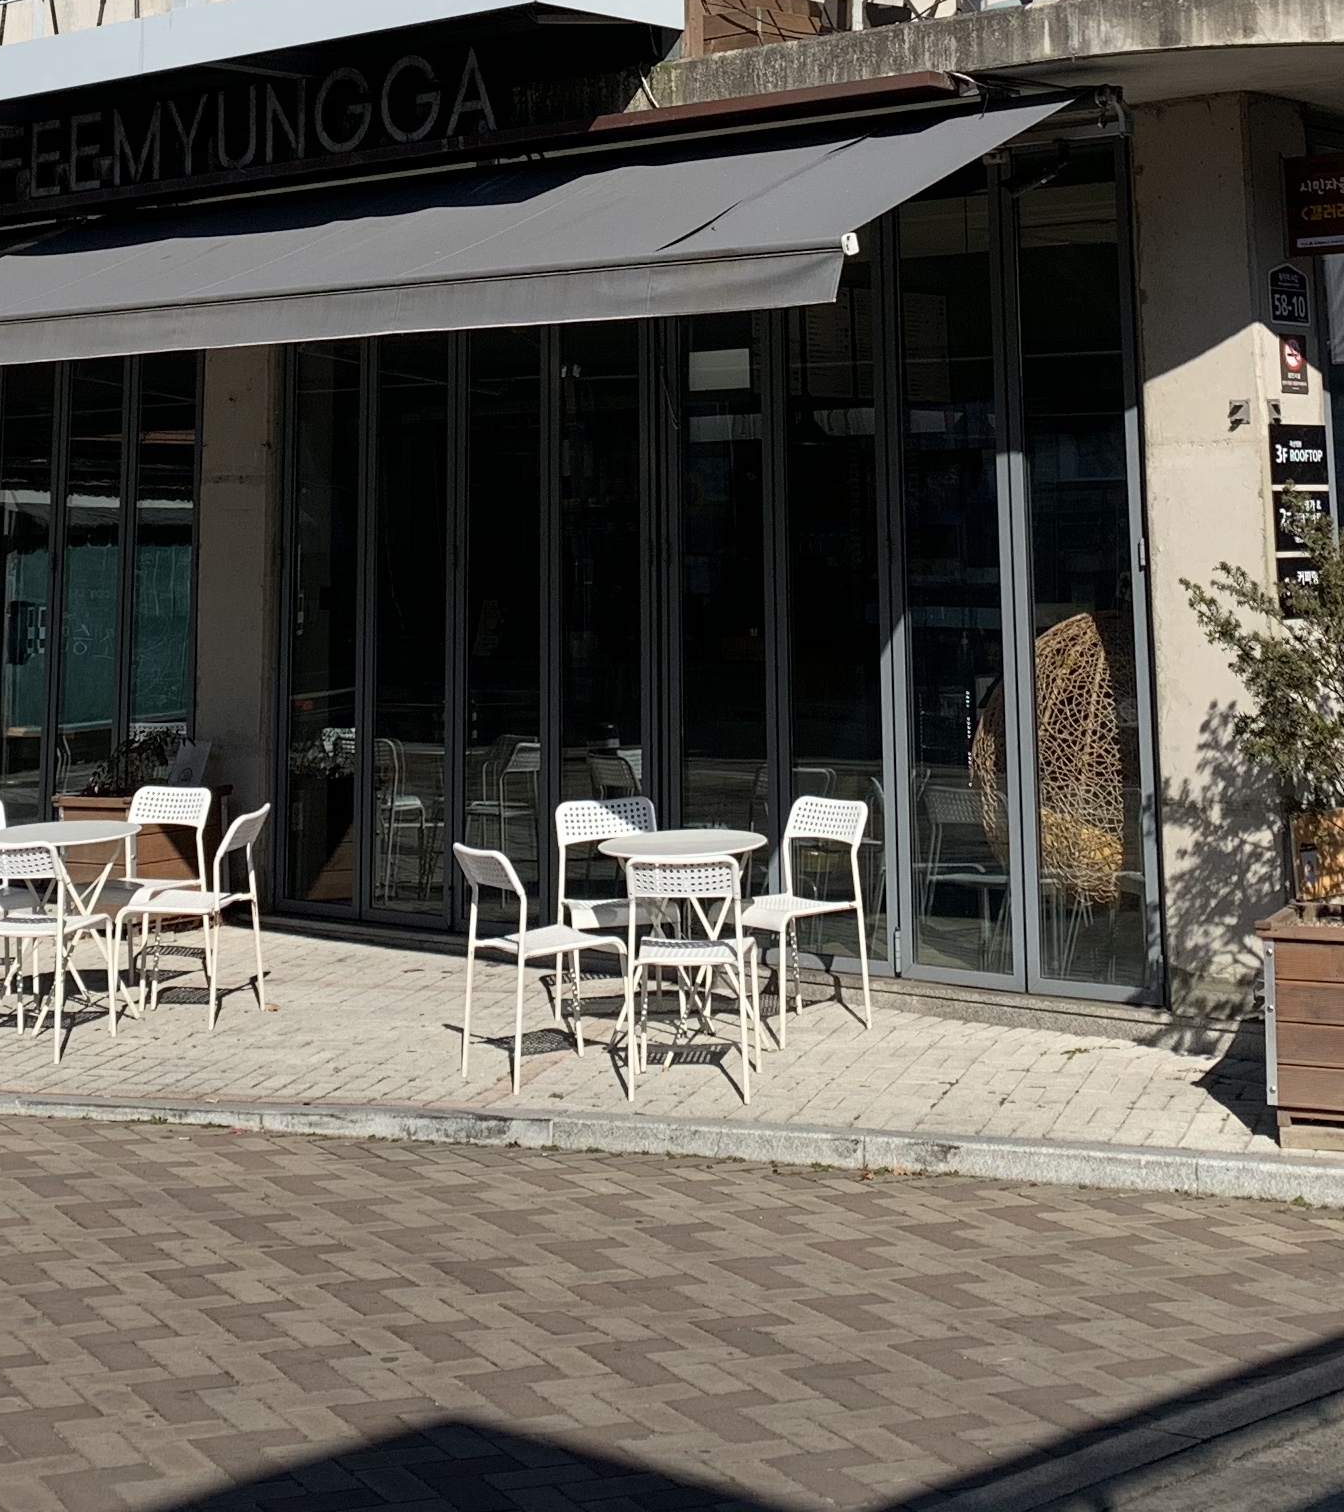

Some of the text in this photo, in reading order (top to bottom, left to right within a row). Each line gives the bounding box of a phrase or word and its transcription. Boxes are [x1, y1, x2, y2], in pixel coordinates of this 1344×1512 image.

[1273, 293, 1306, 318] 58-10
[1274, 443, 1289, 464] 3F
[1289, 448, 1323, 463] ROOFTOP
[1296, 570, 1320, 586] 커피명
